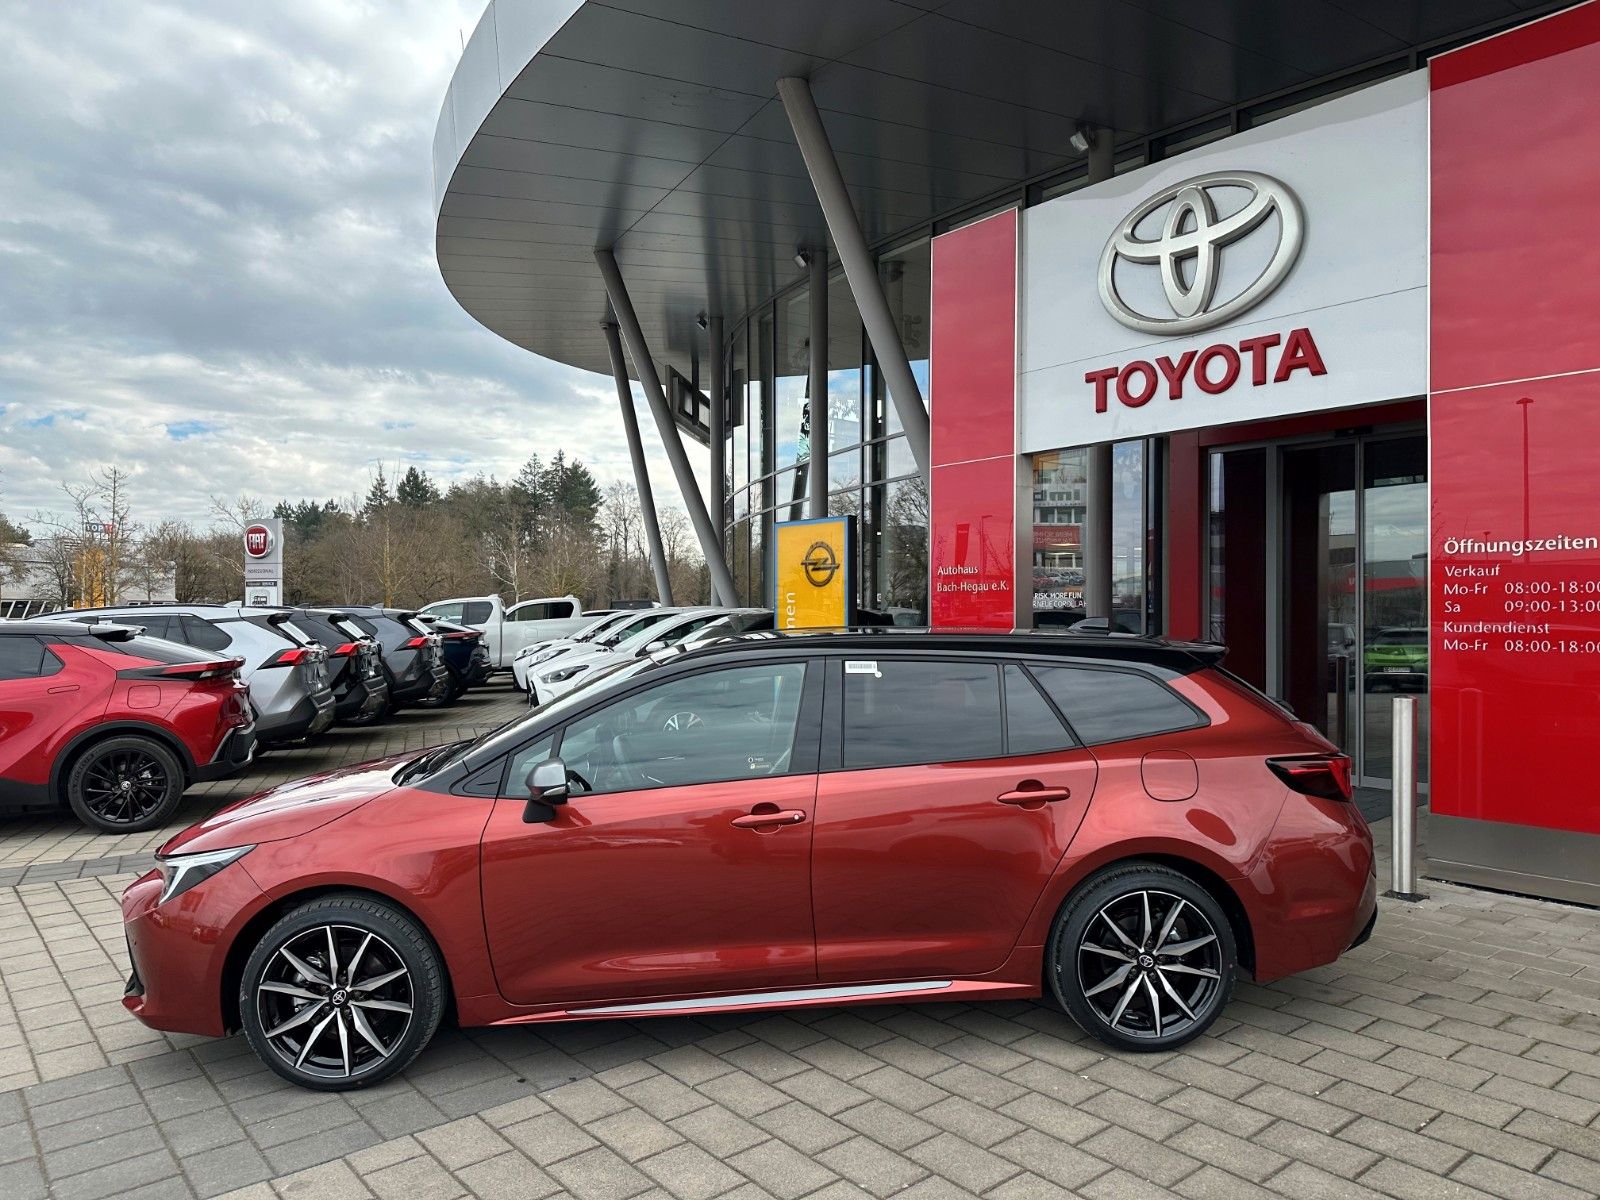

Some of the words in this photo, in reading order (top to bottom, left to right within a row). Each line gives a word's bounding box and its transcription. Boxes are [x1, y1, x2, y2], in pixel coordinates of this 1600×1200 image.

[1085, 327, 1328, 414] TOYOTA
[1443, 535, 1598, 556] Öffnungszeiten
[937, 564, 979, 575] Autohaus
[1444, 564, 1500, 577] Verkauf
[937, 581, 989, 594] Bach-Hegau
[991, 580, 1009, 591] e.K.
[1443, 582, 1488, 595] Mo-Fr
[1444, 600, 1461, 613] Sa
[1443, 621, 1550, 634] Kundendienst
[1443, 638, 1489, 651] Mo-Fr
